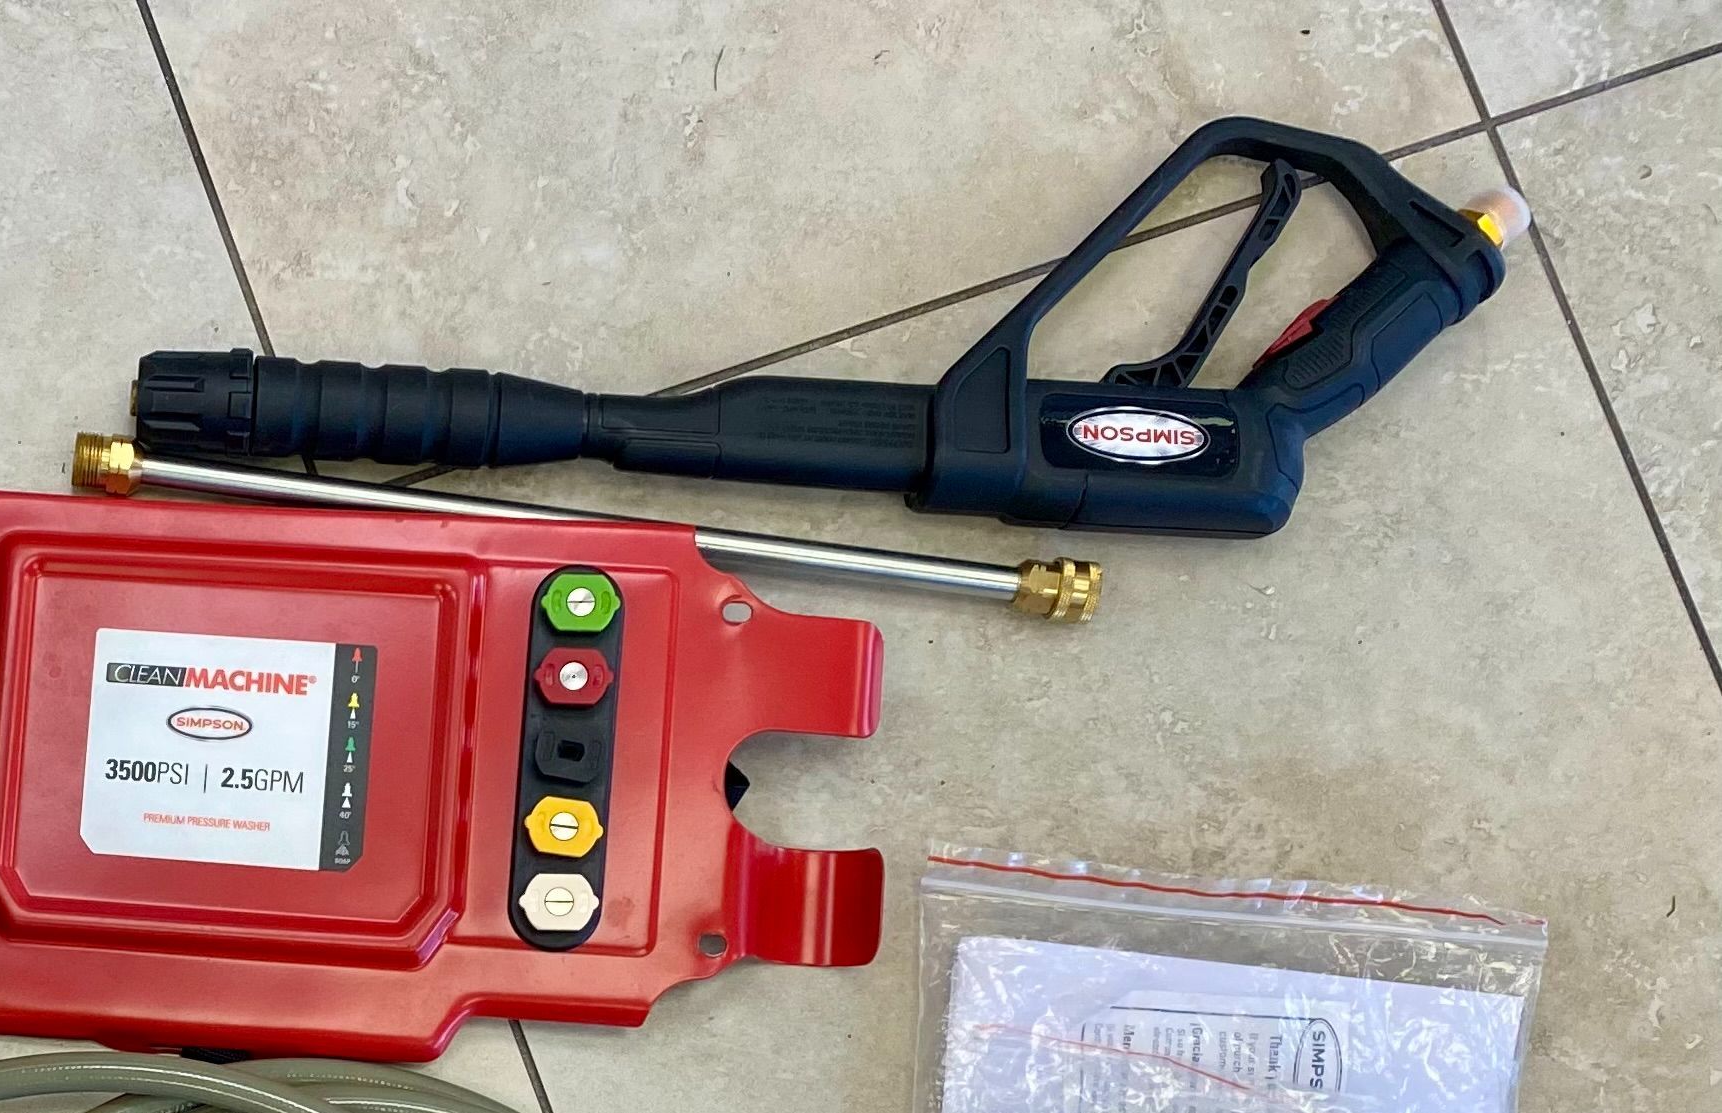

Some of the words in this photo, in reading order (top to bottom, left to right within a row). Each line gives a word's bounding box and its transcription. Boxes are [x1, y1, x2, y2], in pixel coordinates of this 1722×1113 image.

[1082, 423, 1195, 446] SIMPSON
[176, 716, 243, 731] SIMPSON
[105, 757, 189, 785] 3500PSI
[220, 766, 303, 793] 2.5GPM
[143, 812, 185, 825] PREMIUM
[187, 815, 230, 828] PRESSURE
[232, 819, 270, 831] WASHER
